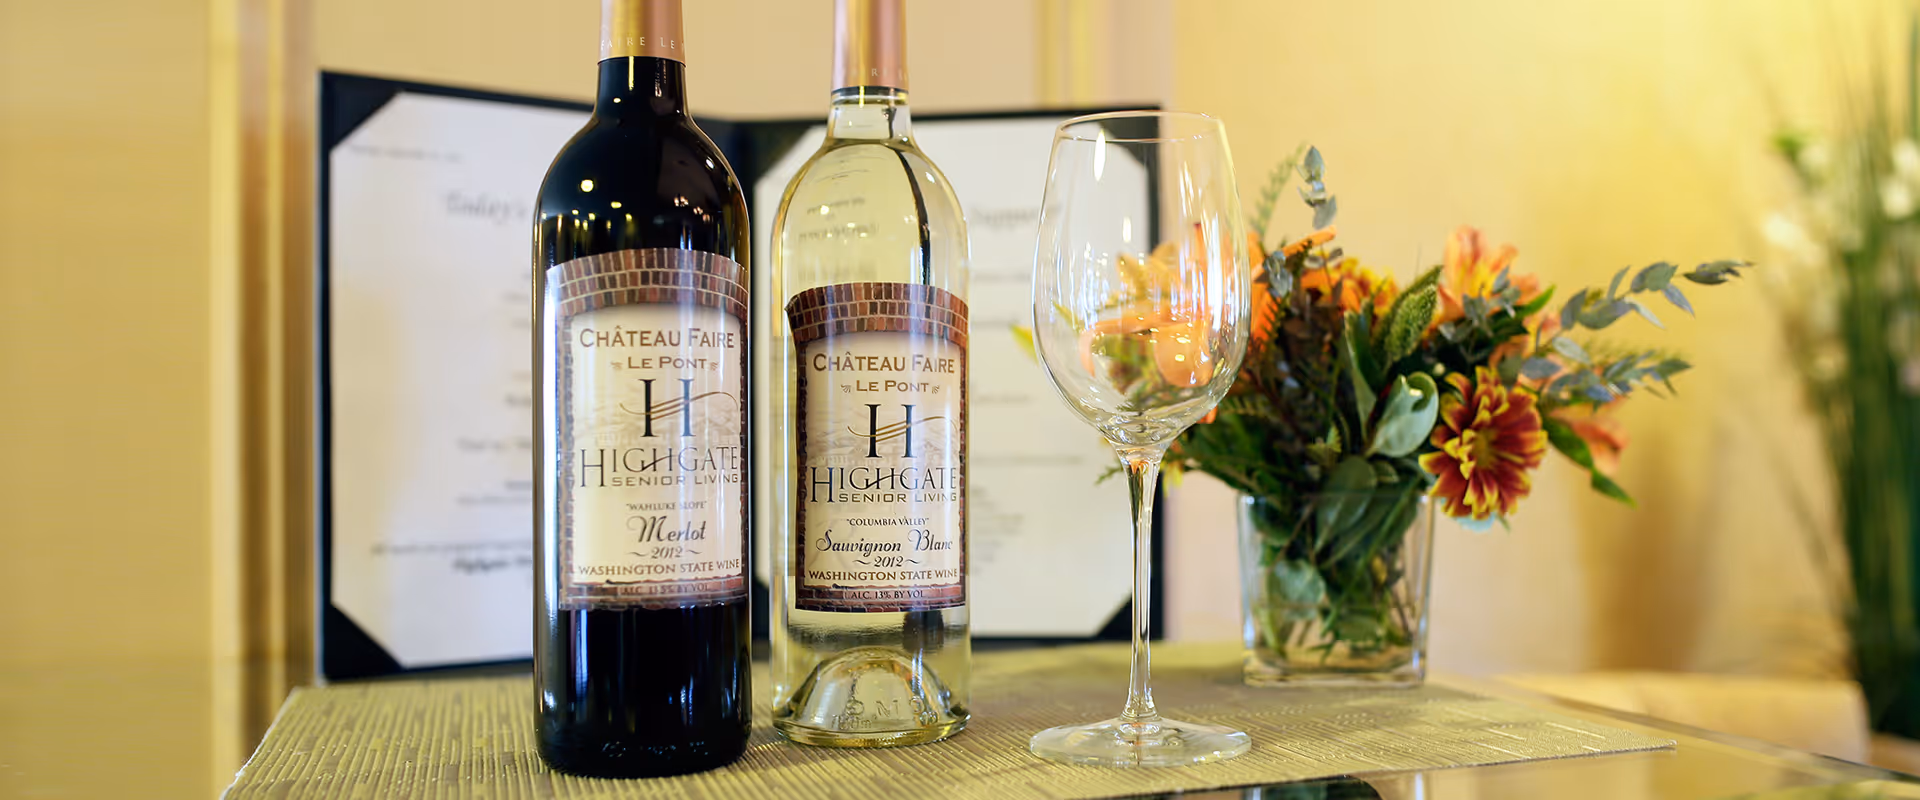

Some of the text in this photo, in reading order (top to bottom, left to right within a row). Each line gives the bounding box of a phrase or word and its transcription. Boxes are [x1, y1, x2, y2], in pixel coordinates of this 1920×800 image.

[580, 325, 735, 348] CHÂTEAU FAIRE
[627, 356, 707, 369] LE PONT
[813, 352, 955, 373] CHÂTEAU FAIRE
[856, 380, 929, 392] LE PONT
[580, 447, 738, 488] HIGHGATE
[611, 473, 739, 487] SENIOR LIVING
[810, 466, 957, 503] HIGHGATE
[838, 493, 957, 503] SENIOR LIVING
[626, 515, 707, 543] Merlot
[815, 528, 953, 557] Sauvignon Blanc
[578, 558, 740, 576] WASHINGTON STATE WINE
[808, 568, 958, 581] WASHINGTON STATE WINE
[875, 590, 892, 599] 13%
[894, 590, 905, 599] BY
